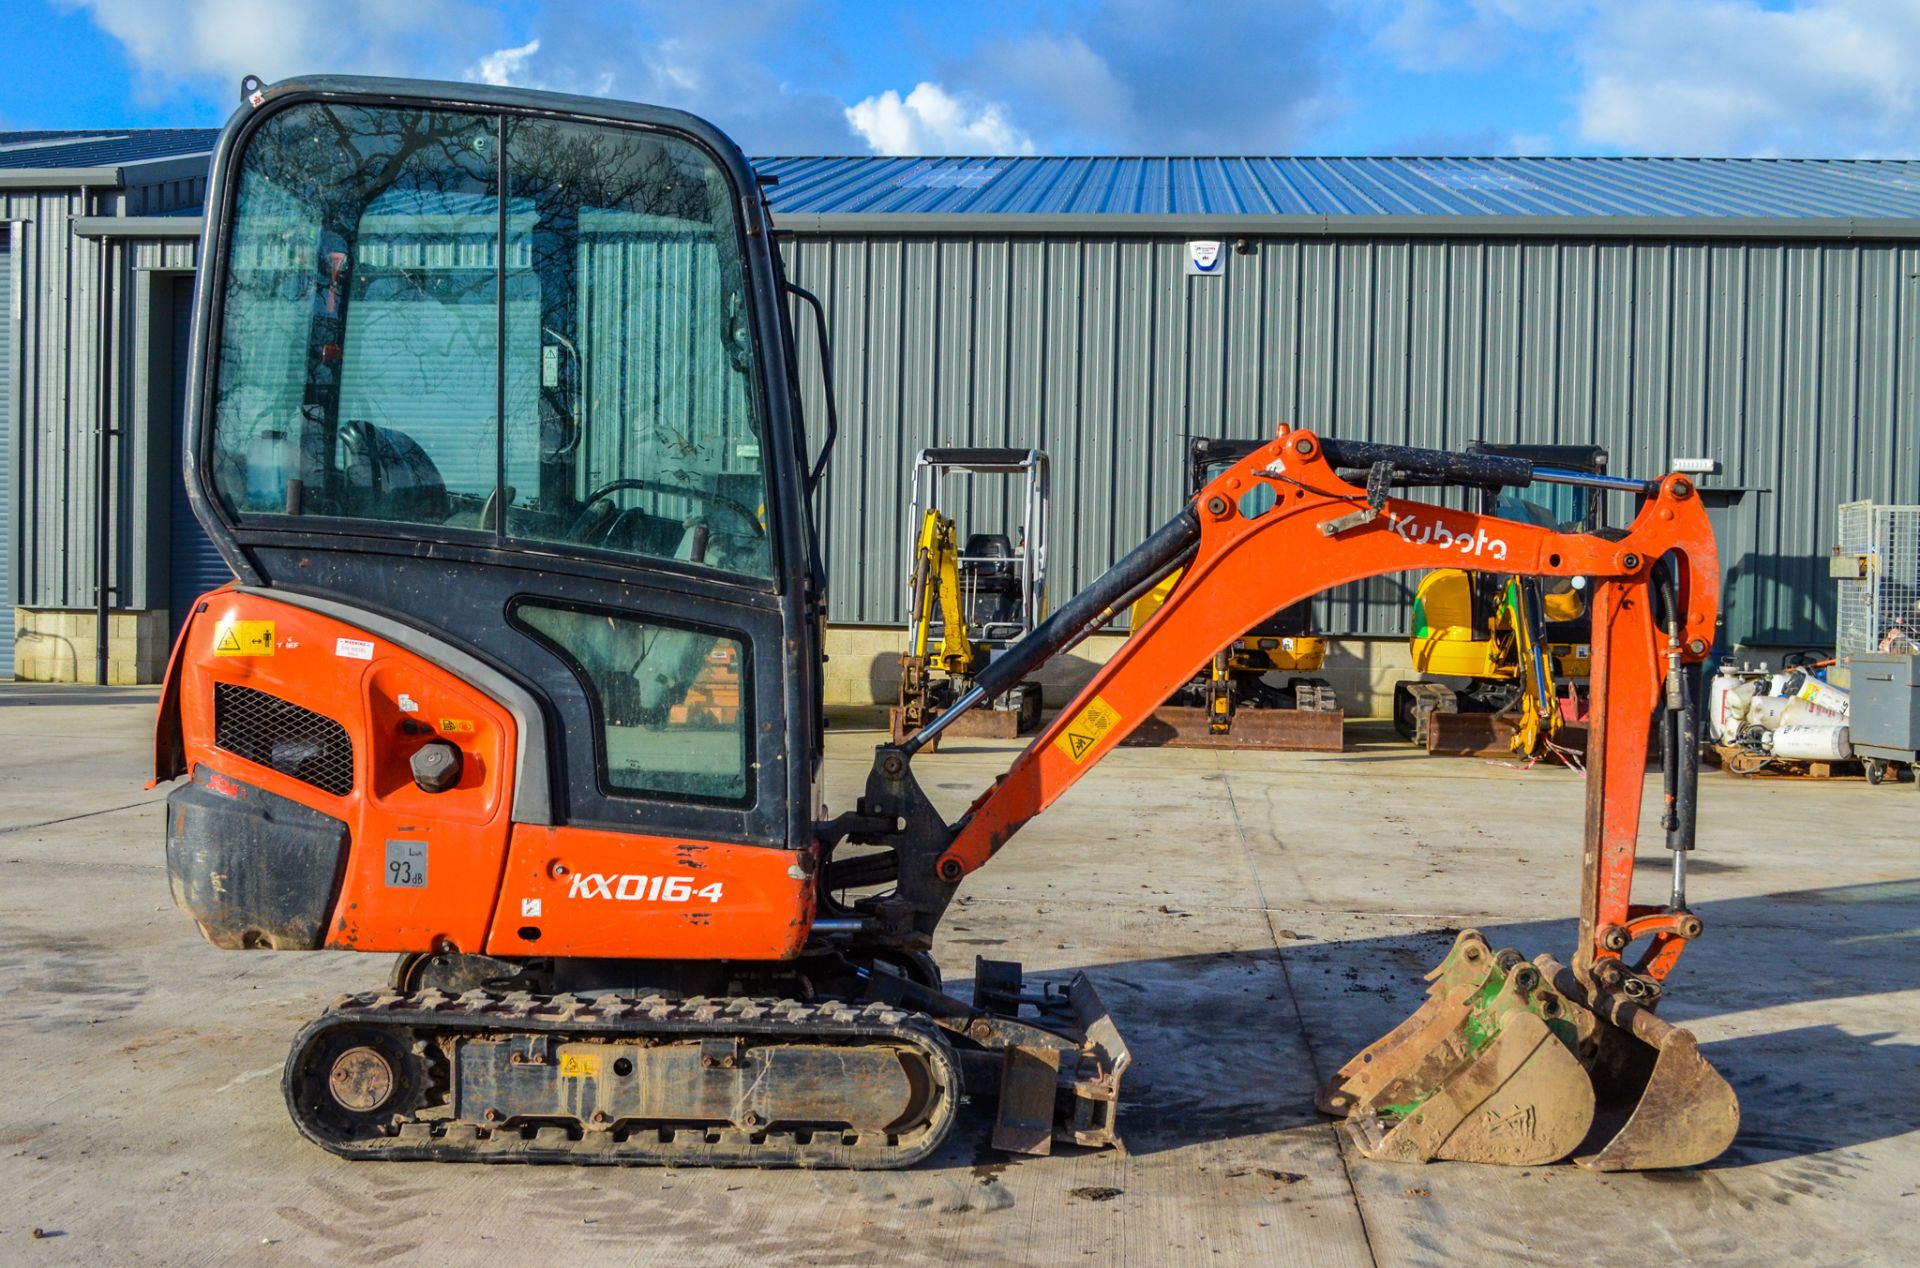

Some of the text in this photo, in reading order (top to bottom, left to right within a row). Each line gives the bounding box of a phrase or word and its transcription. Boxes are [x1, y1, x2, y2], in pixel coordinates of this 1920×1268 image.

[1388, 512, 1507, 560] Kubota
[390, 861, 422, 884] 93 dB
[568, 873, 723, 903] KX016-4
